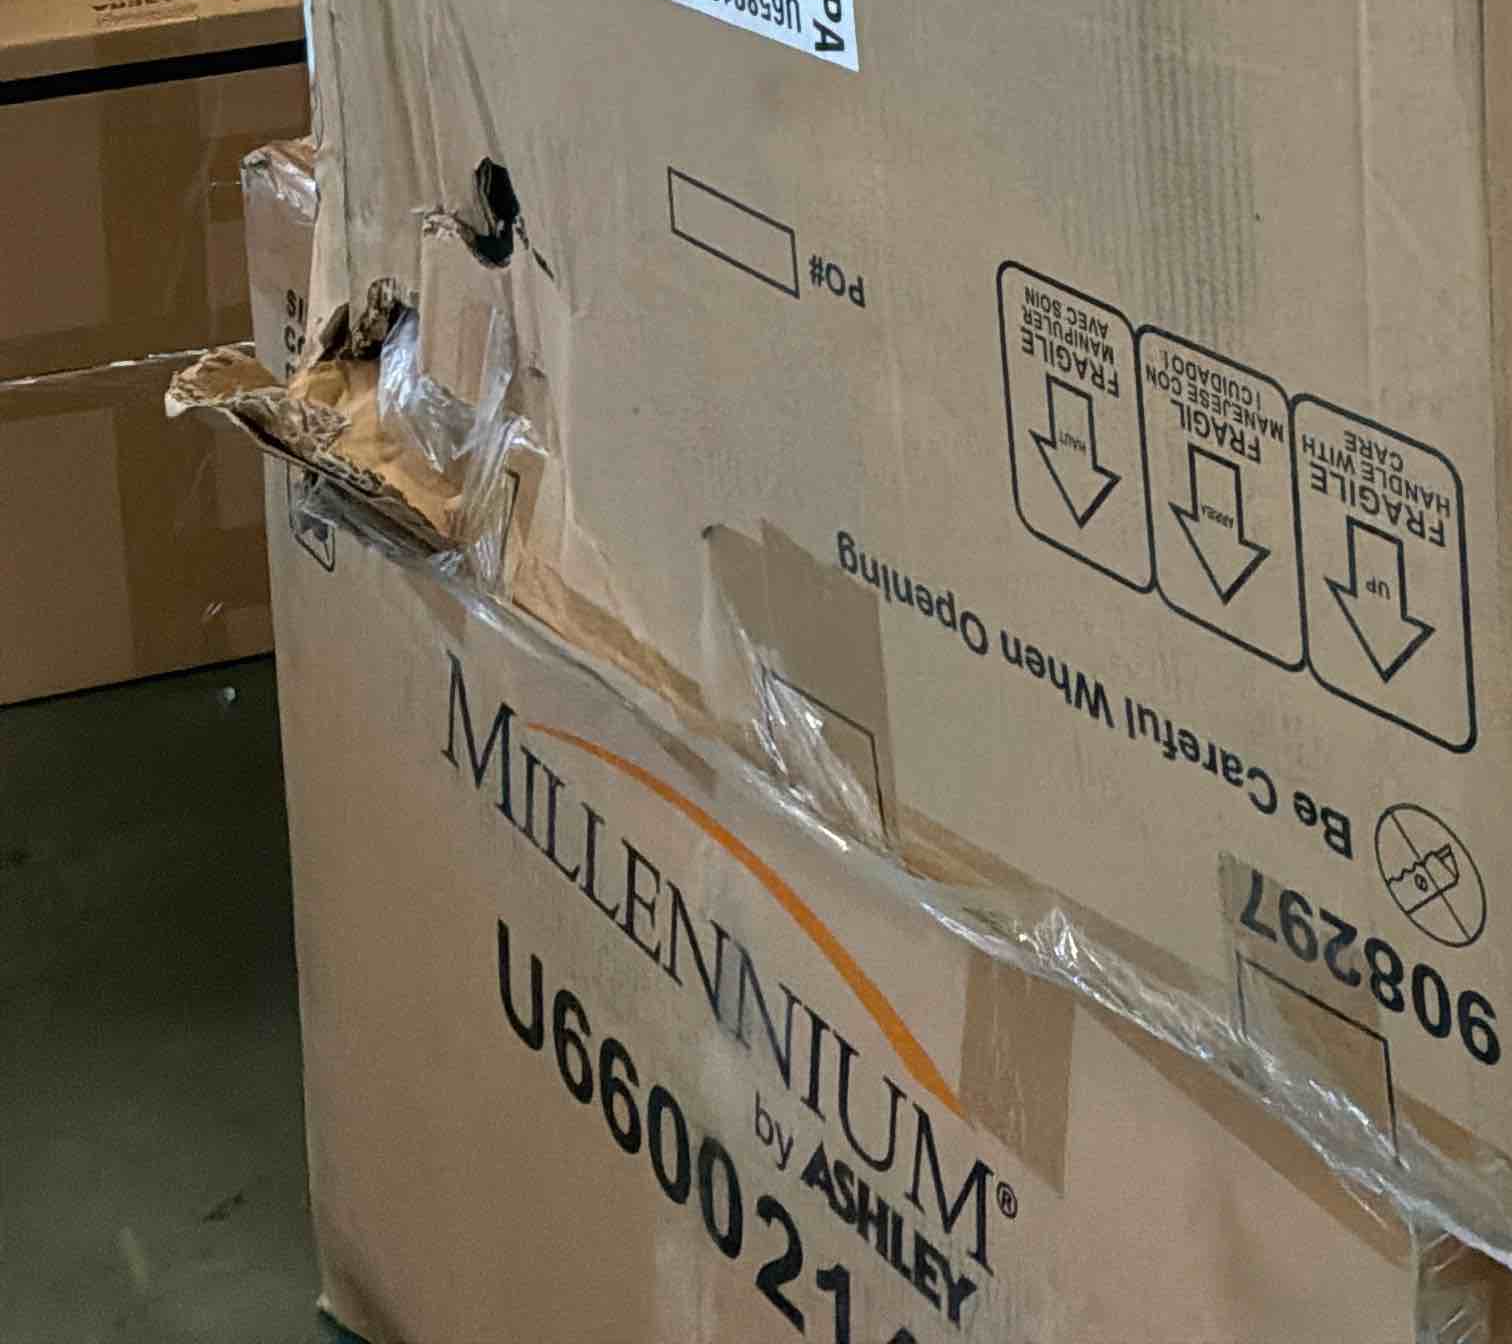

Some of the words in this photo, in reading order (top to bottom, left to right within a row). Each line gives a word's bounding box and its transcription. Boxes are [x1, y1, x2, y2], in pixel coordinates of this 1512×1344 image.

[808, 254, 866, 308] PO#
[1023, 286, 1062, 323] SOIN
[1022, 306, 1115, 362] MANIPULER
[1064, 302, 1110, 339] AVEC
[1021, 328, 1120, 399] FRAGILE
[1145, 365, 1184, 398] CON
[1179, 397, 1261, 463] FRAGIL
[1188, 376, 1285, 444] MANEJESE
[1302, 433, 1354, 476] WITH
[1344, 429, 1405, 466] CARE
[1310, 462, 1447, 548] FRAGILE
[1359, 459, 1451, 516] HANDLE
[836, 531, 990, 656] Opening
[1365, 575, 1391, 601] UP
[1001, 630, 1116, 729] When
[1125, 697, 1278, 815] Careful
[1294, 790, 1353, 860] Be
[1239, 867, 1501, 1066] 908297
[497, 917, 918, 1344] U660021
[754, 1090, 795, 1172] by
[800, 1140, 979, 1331] ASHLEY
